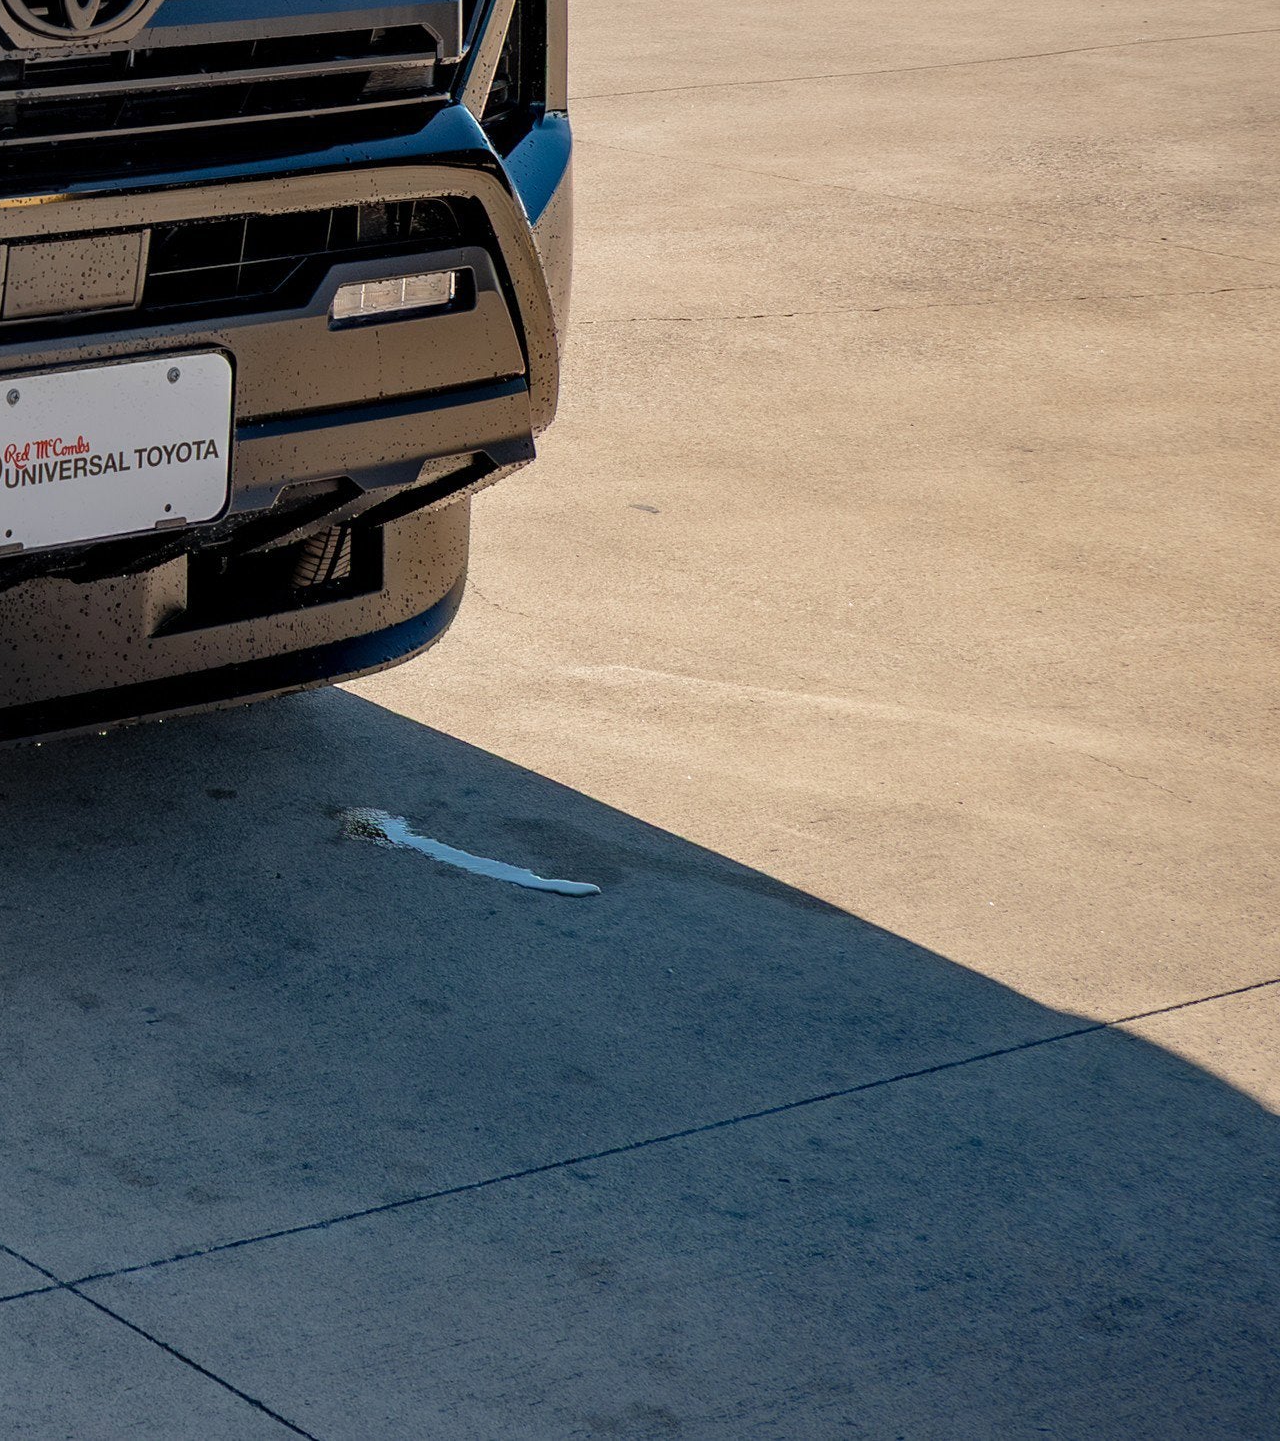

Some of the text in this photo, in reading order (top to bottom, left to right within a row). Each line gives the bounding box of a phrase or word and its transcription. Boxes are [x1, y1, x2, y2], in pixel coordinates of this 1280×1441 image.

[4, 435, 90, 470] Red McCombs
[4, 439, 219, 489] UNIVERSAL TOYOTA
